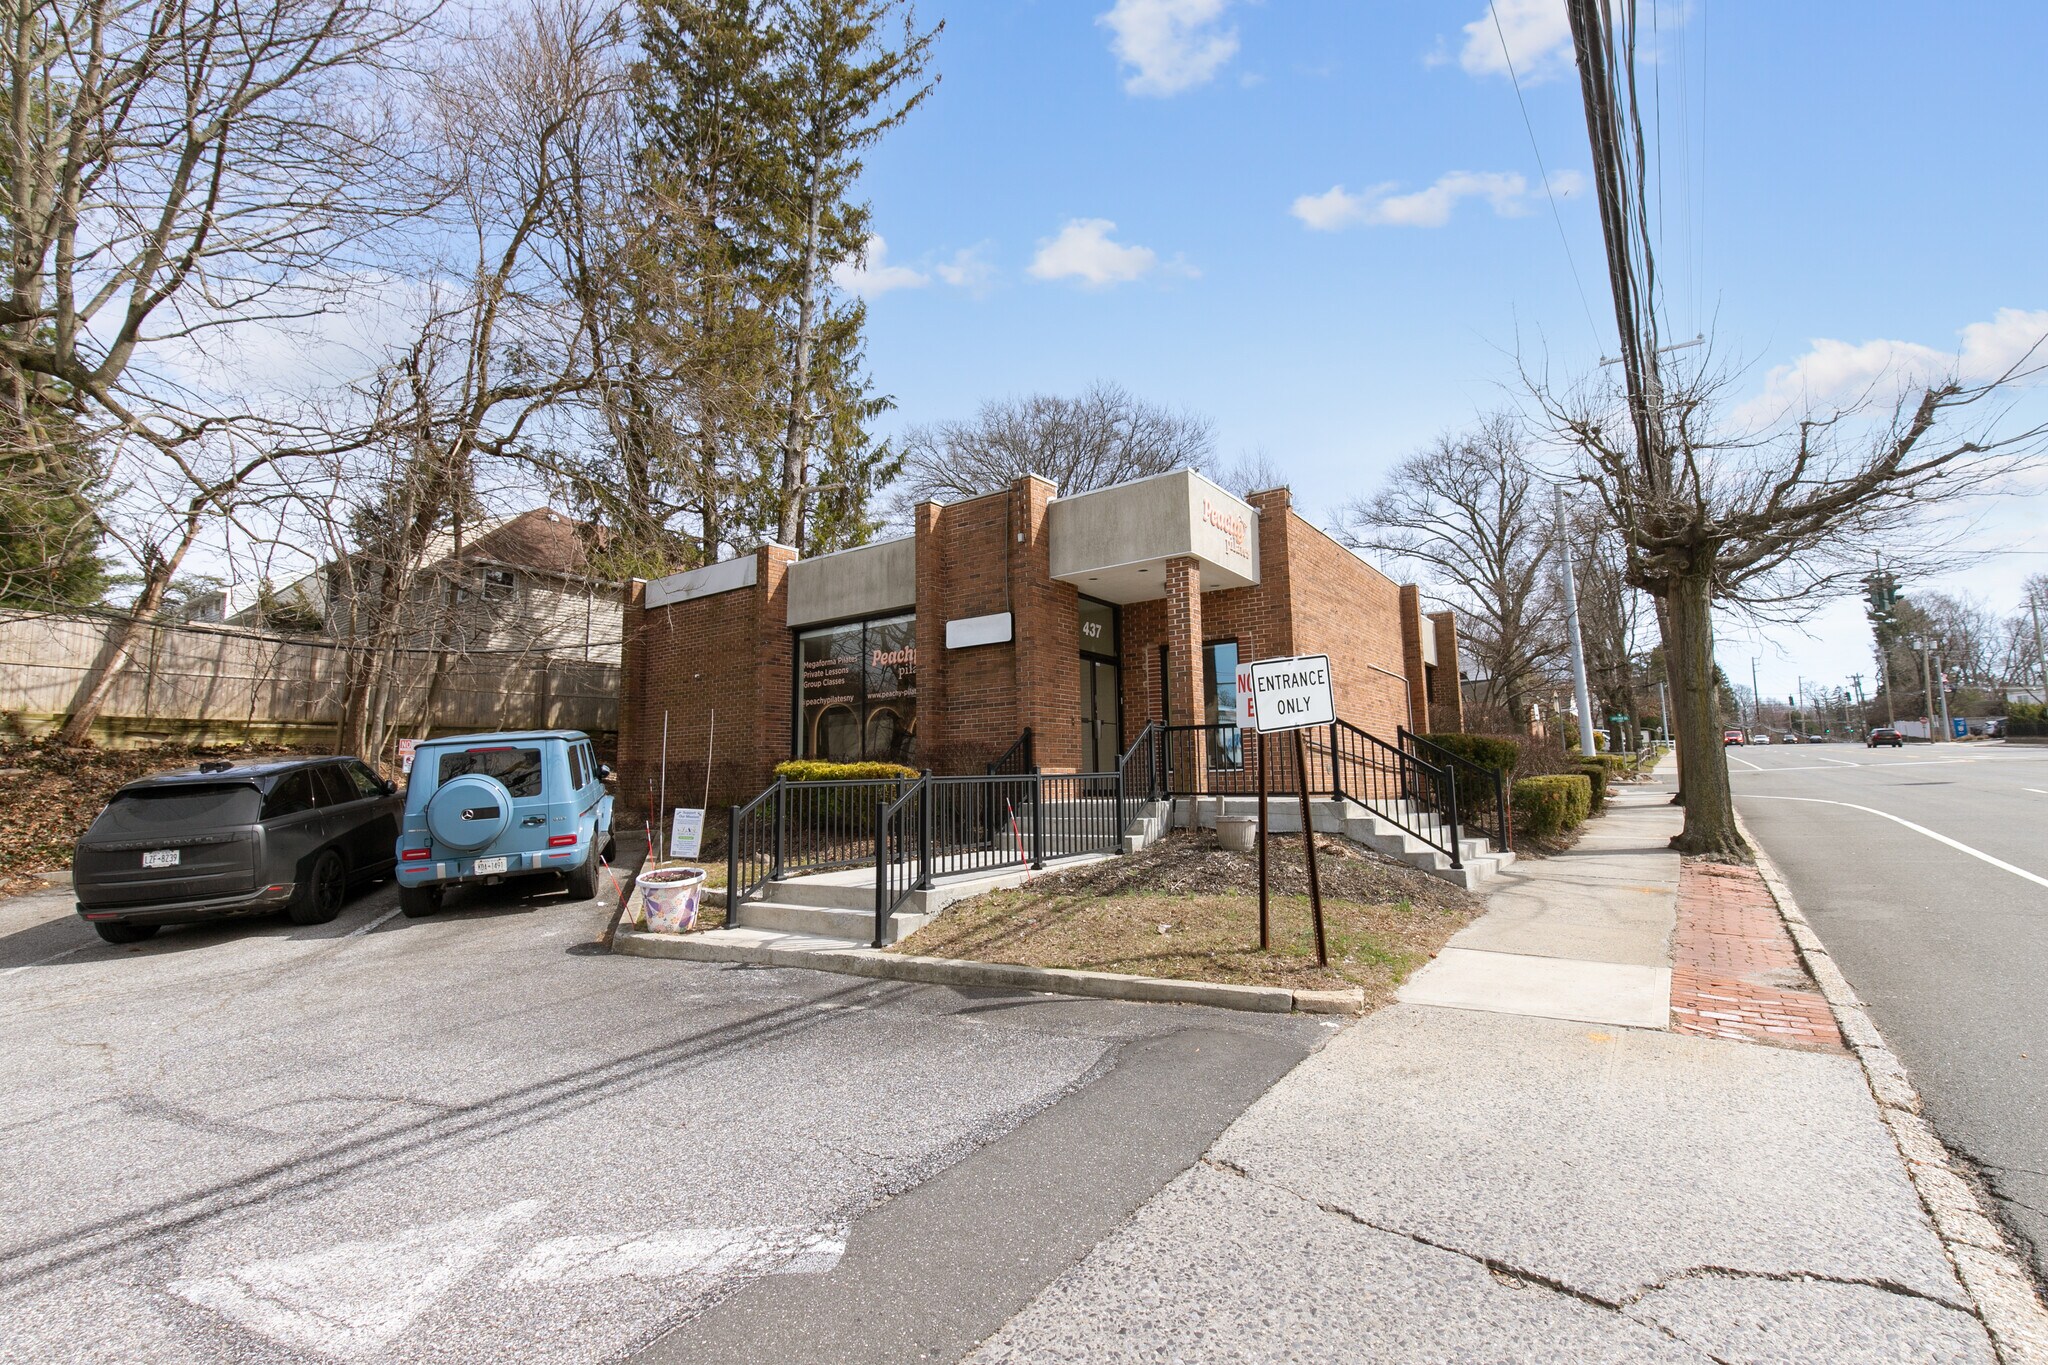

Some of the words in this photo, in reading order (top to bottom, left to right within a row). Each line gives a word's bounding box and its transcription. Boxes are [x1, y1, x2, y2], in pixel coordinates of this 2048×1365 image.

[1203, 498, 1246, 545] Peachy
[1083, 621, 1101, 638] 437
[837, 655, 858, 665] Pilates
[803, 670, 824, 678] Private
[825, 667, 849, 676] Lessons
[1258, 670, 1325, 692] ENTRANCE
[823, 677, 845, 686] Classes
[1277, 696, 1311, 715] ONLY
